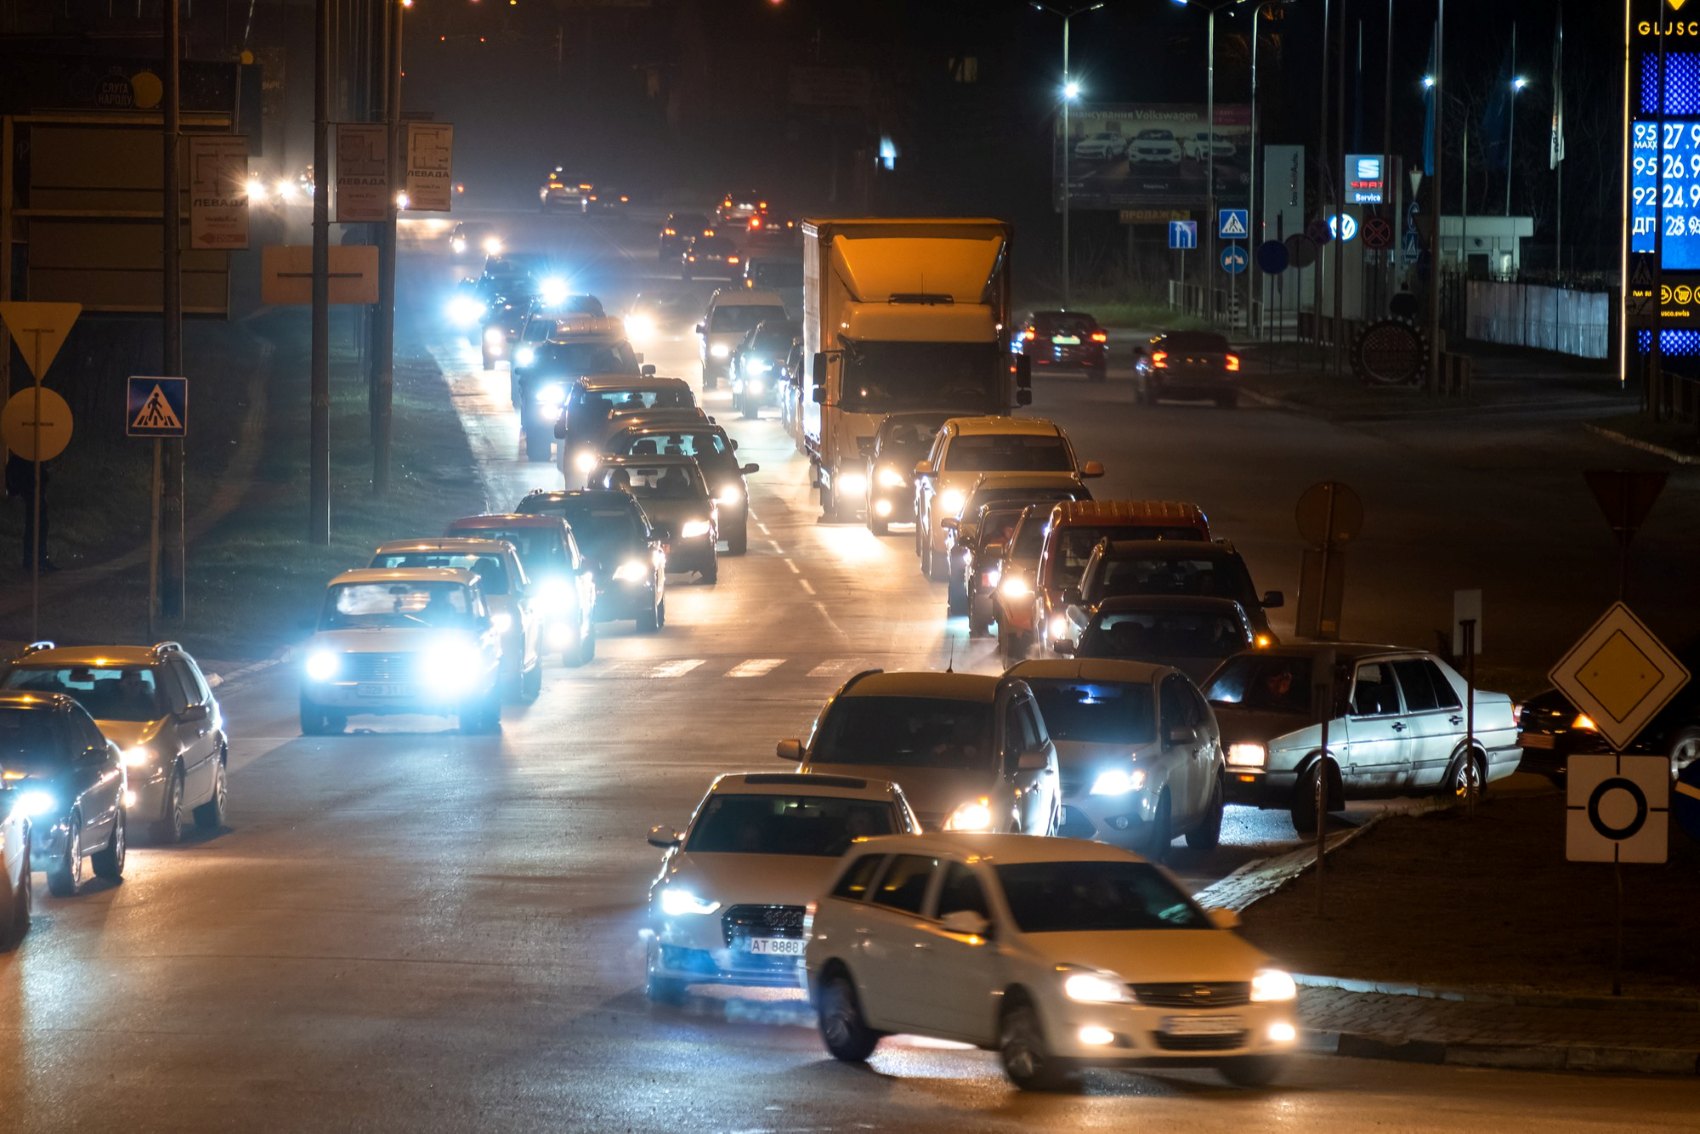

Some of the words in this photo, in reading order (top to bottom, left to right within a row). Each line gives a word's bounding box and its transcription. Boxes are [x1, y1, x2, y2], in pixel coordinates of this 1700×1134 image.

[1135, 110, 1198, 121] Volkswagen
[1634, 124, 1657, 141] 95
[1632, 157, 1657, 176] 95
[407, 170, 449, 178] ЛЕВАДА
[338, 178, 386, 186] ЛЕВАДА
[1354, 193, 1381, 202] Service
[1632, 187, 1657, 206] 92
[1632, 217, 1656, 236] ДП
[752, 940, 768, 952] AT
